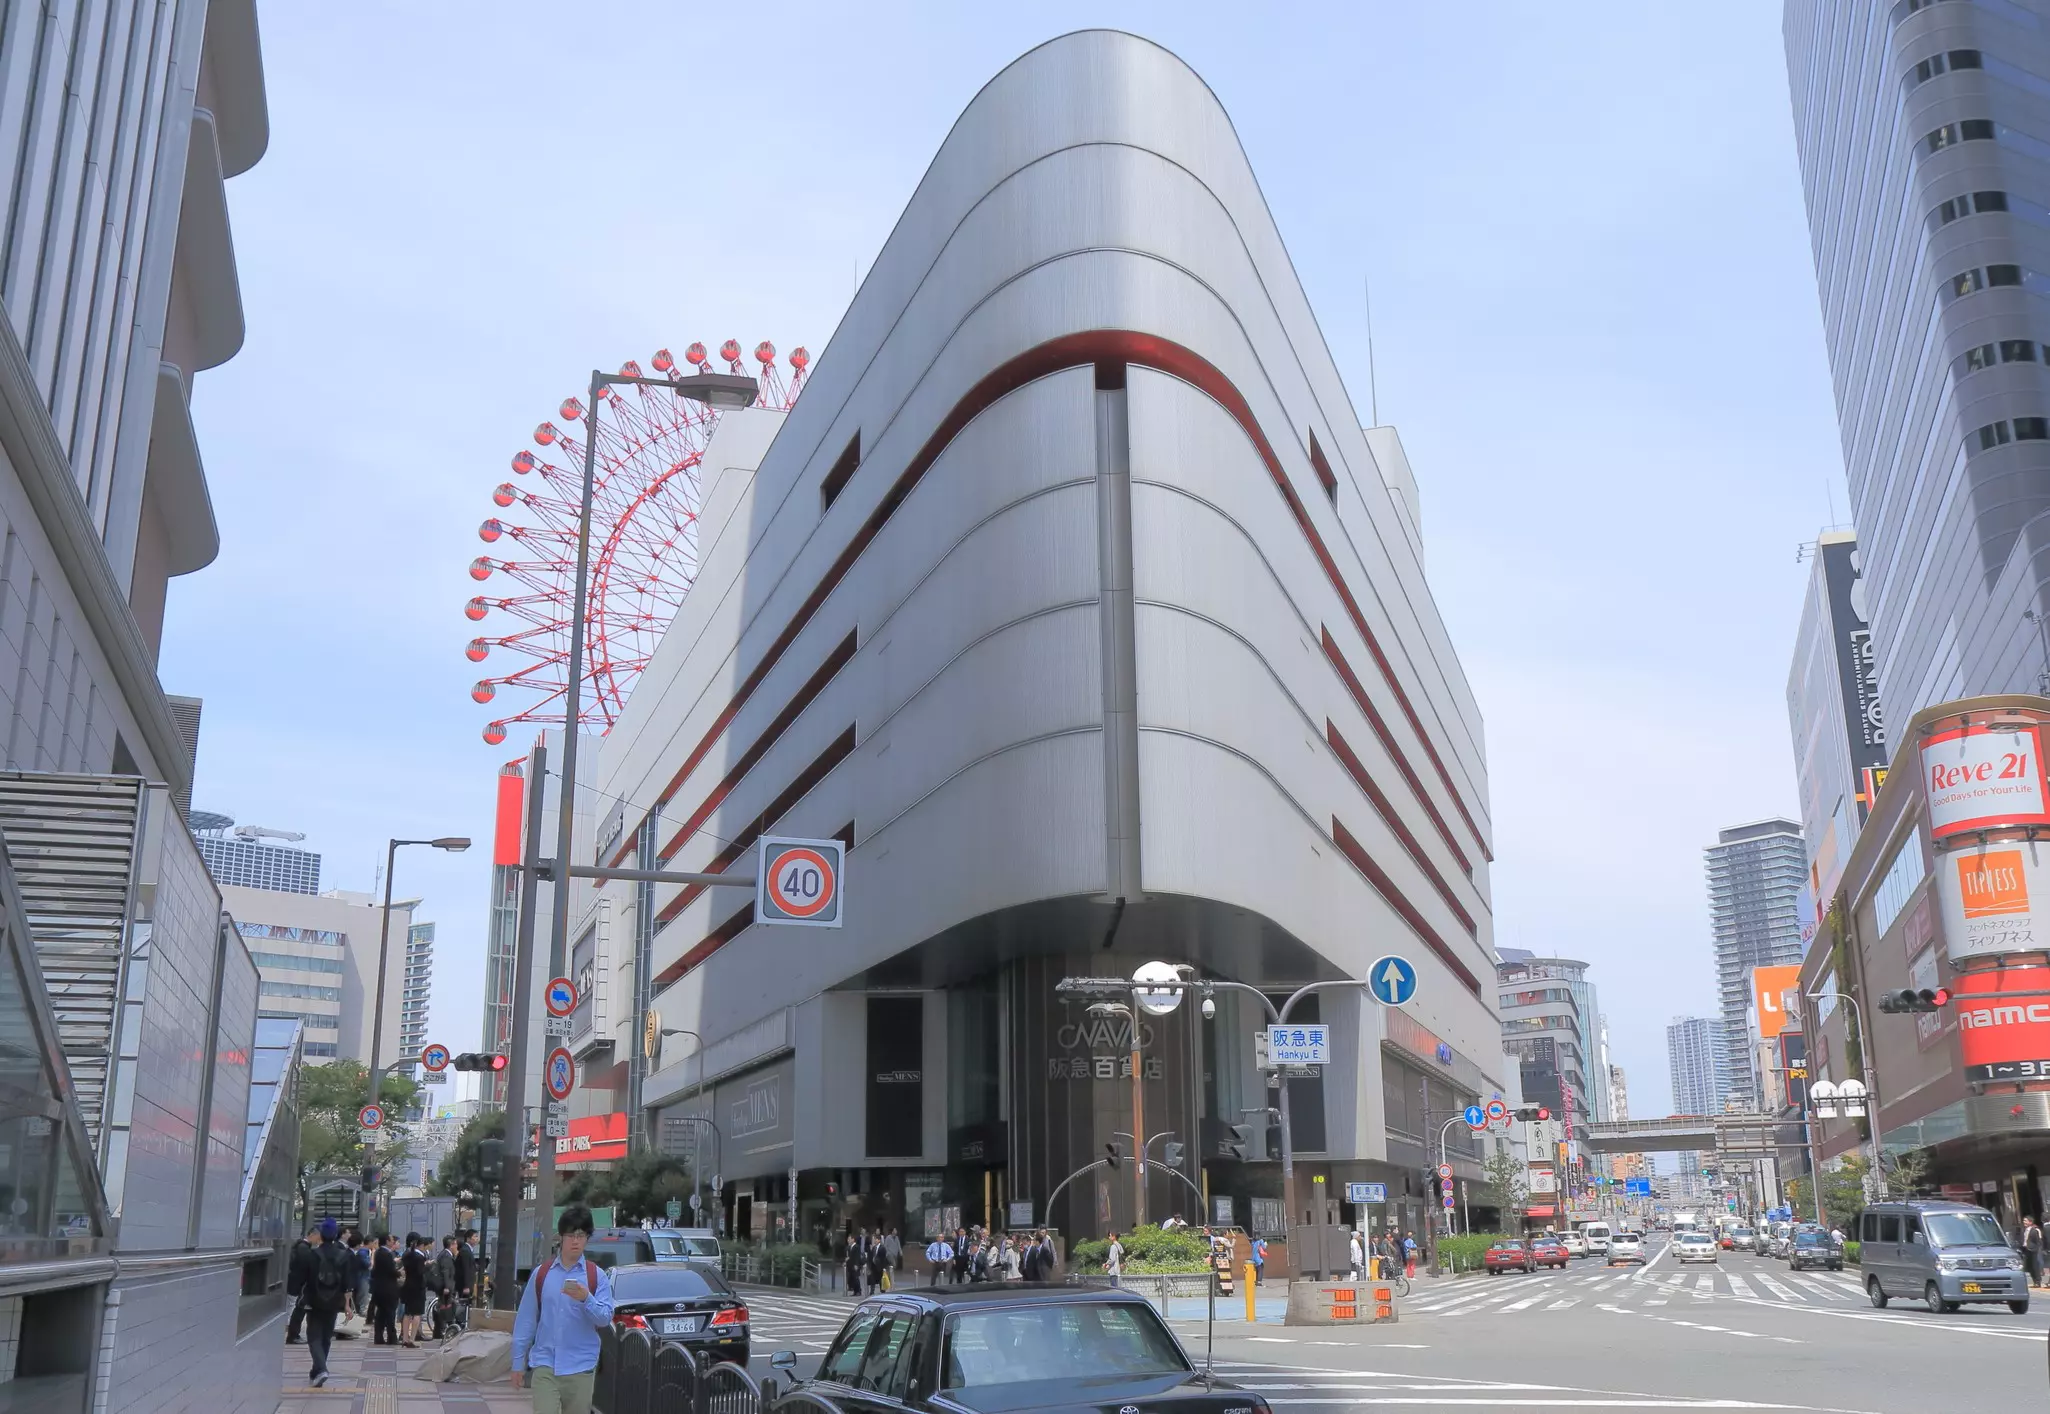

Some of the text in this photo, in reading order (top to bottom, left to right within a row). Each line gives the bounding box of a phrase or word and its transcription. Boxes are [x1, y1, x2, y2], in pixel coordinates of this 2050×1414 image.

[1851, 643, 1871, 745] SPORTS ENTERTAINMENT
[1931, 753, 2027, 793] Reve 21
[1933, 784, 2032, 807] Good Days for Your Life
[784, 867, 820, 898] 40
[1966, 860, 2017, 900] TIPNESS
[1273, 1030, 1324, 1047] 阪急東
[1048, 1055, 1163, 1080] 阪急百貨店
[1277, 1050, 1321, 1060] Hankyu E.
[573, 1135, 591, 1151] PARK
